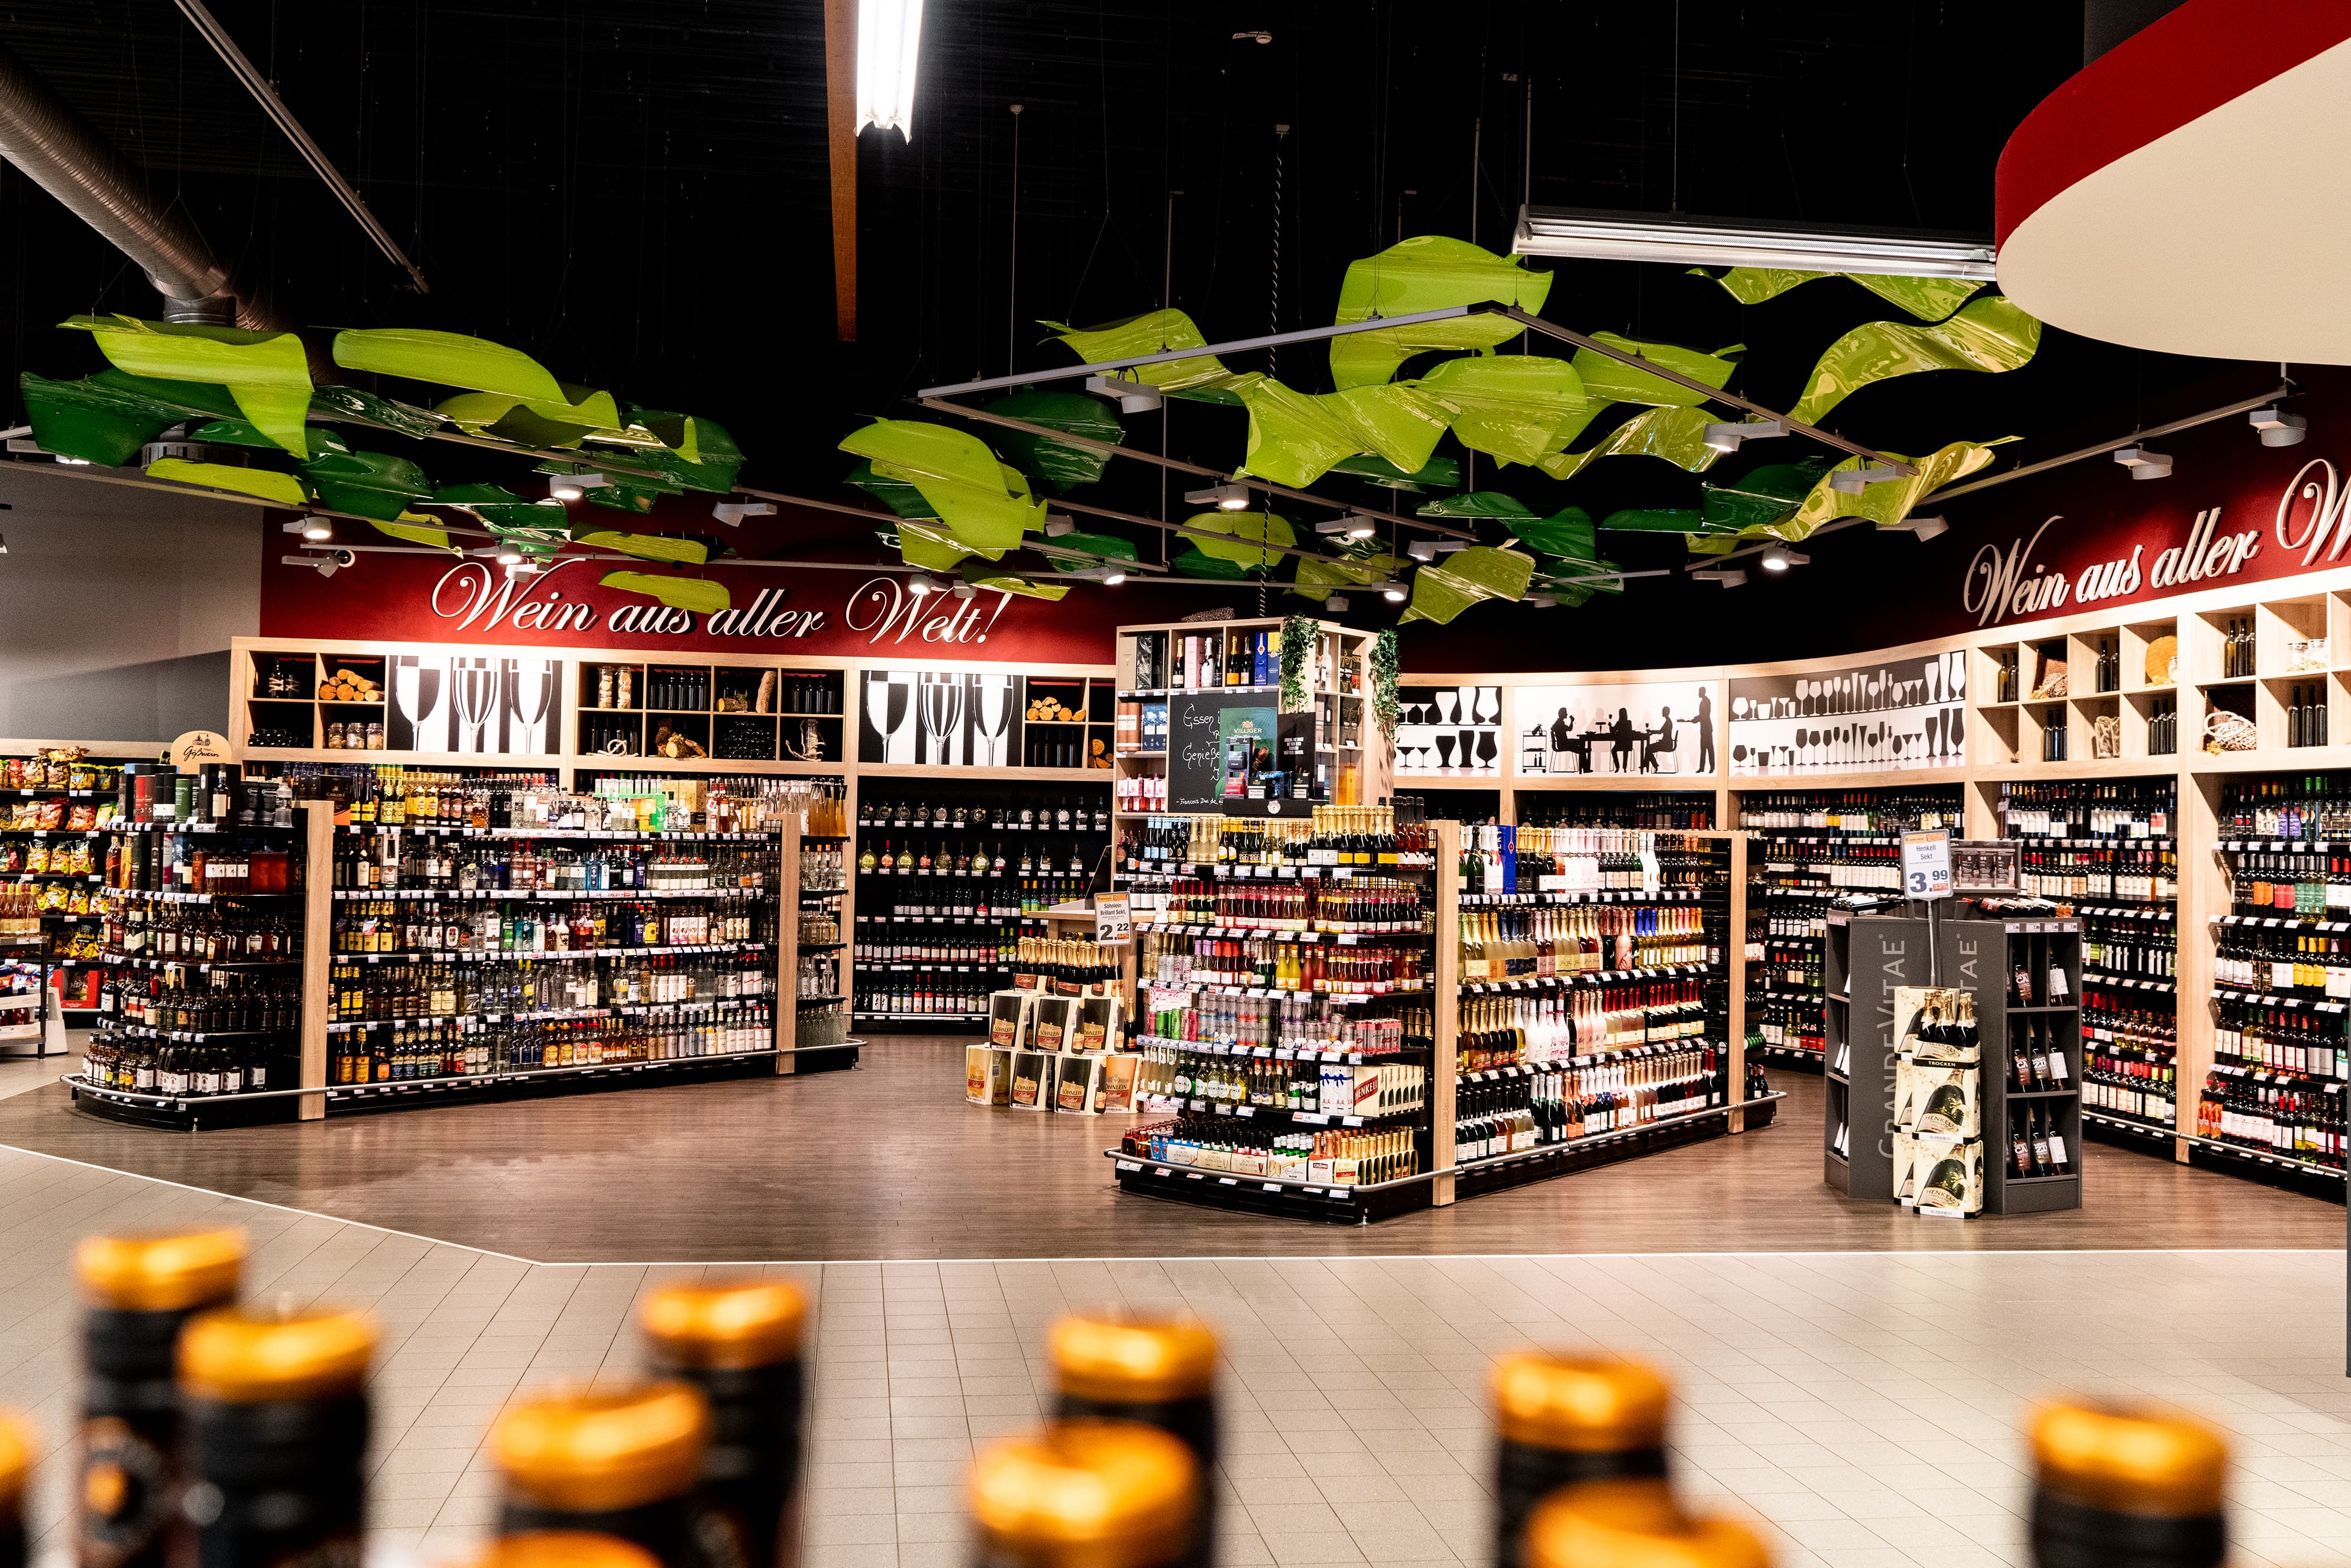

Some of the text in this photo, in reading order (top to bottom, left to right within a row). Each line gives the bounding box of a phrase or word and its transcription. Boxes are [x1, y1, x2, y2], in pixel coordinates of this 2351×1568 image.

[1964, 516, 2071, 626] Wein
[2076, 545, 2143, 604] aus
[2151, 507, 2259, 588] aller
[432, 558, 1013, 644] Wein aus aller Welt!
[1183, 704, 1214, 733] Essen
[183, 746, 219, 762] Gößwein
[1183, 743, 1220, 769] Genieße
[1355, 1077, 1378, 1100] HENKELL
